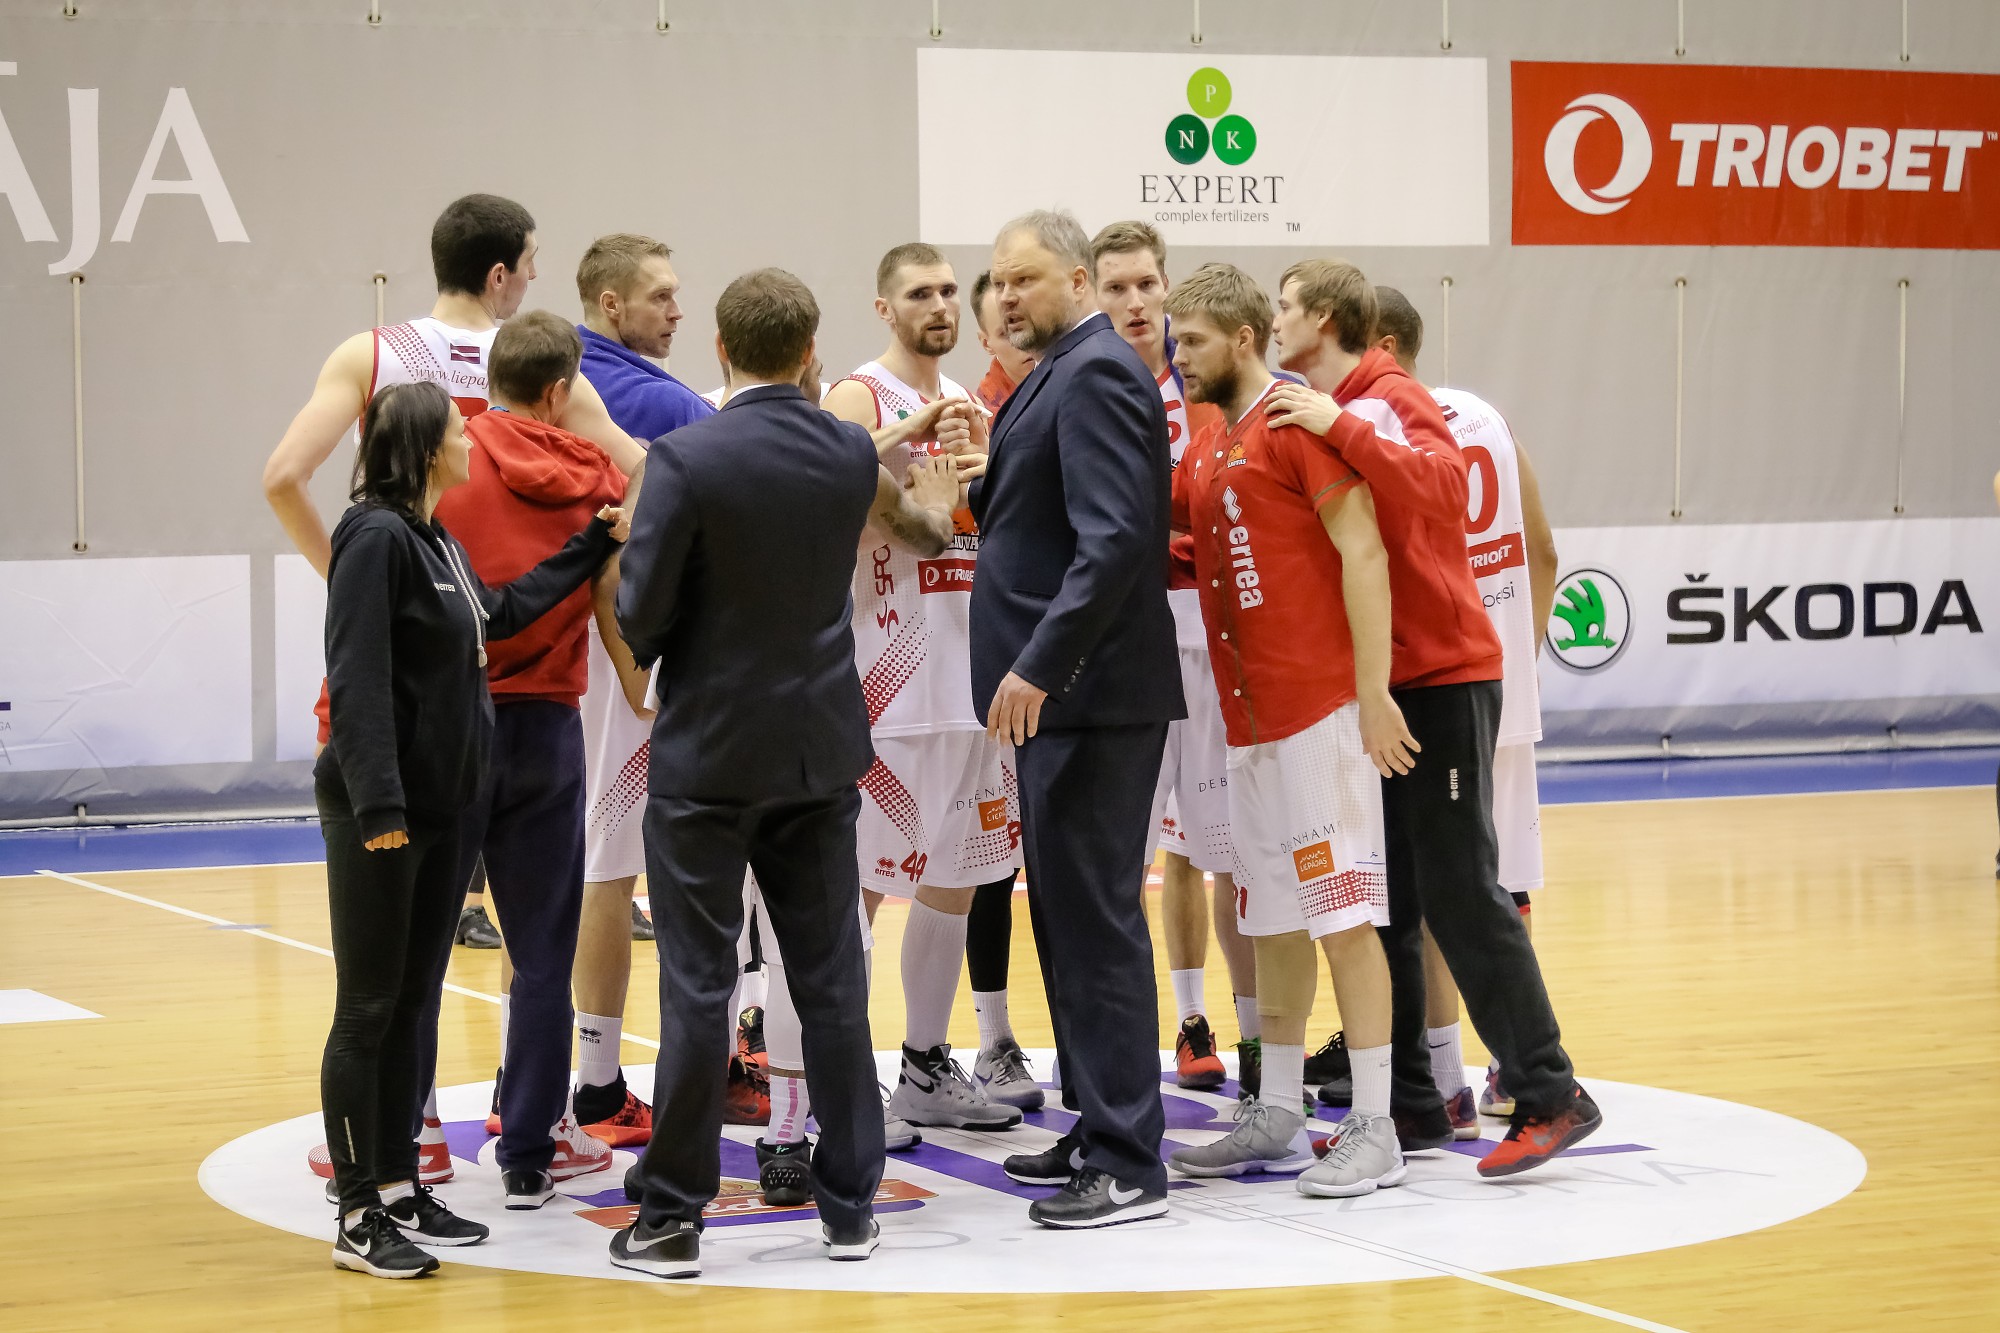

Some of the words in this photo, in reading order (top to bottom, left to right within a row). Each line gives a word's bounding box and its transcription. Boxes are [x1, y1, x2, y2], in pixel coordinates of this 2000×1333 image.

[1205, 84, 1217, 103] P
[1178, 130, 1195, 150] N
[1226, 130, 1242, 150] K
[1669, 123, 1984, 193] TRIOBET
[1139, 174, 1285, 204] EXPERT
[1155, 209, 1209, 225] complex
[1211, 209, 1270, 223] fertilizers
[1286, 222, 1300, 232] TM
[1666, 573, 1984, 645] ŠKODA
[874, 867, 896, 878] errea
[679, 1221, 695, 1230] NIKE
